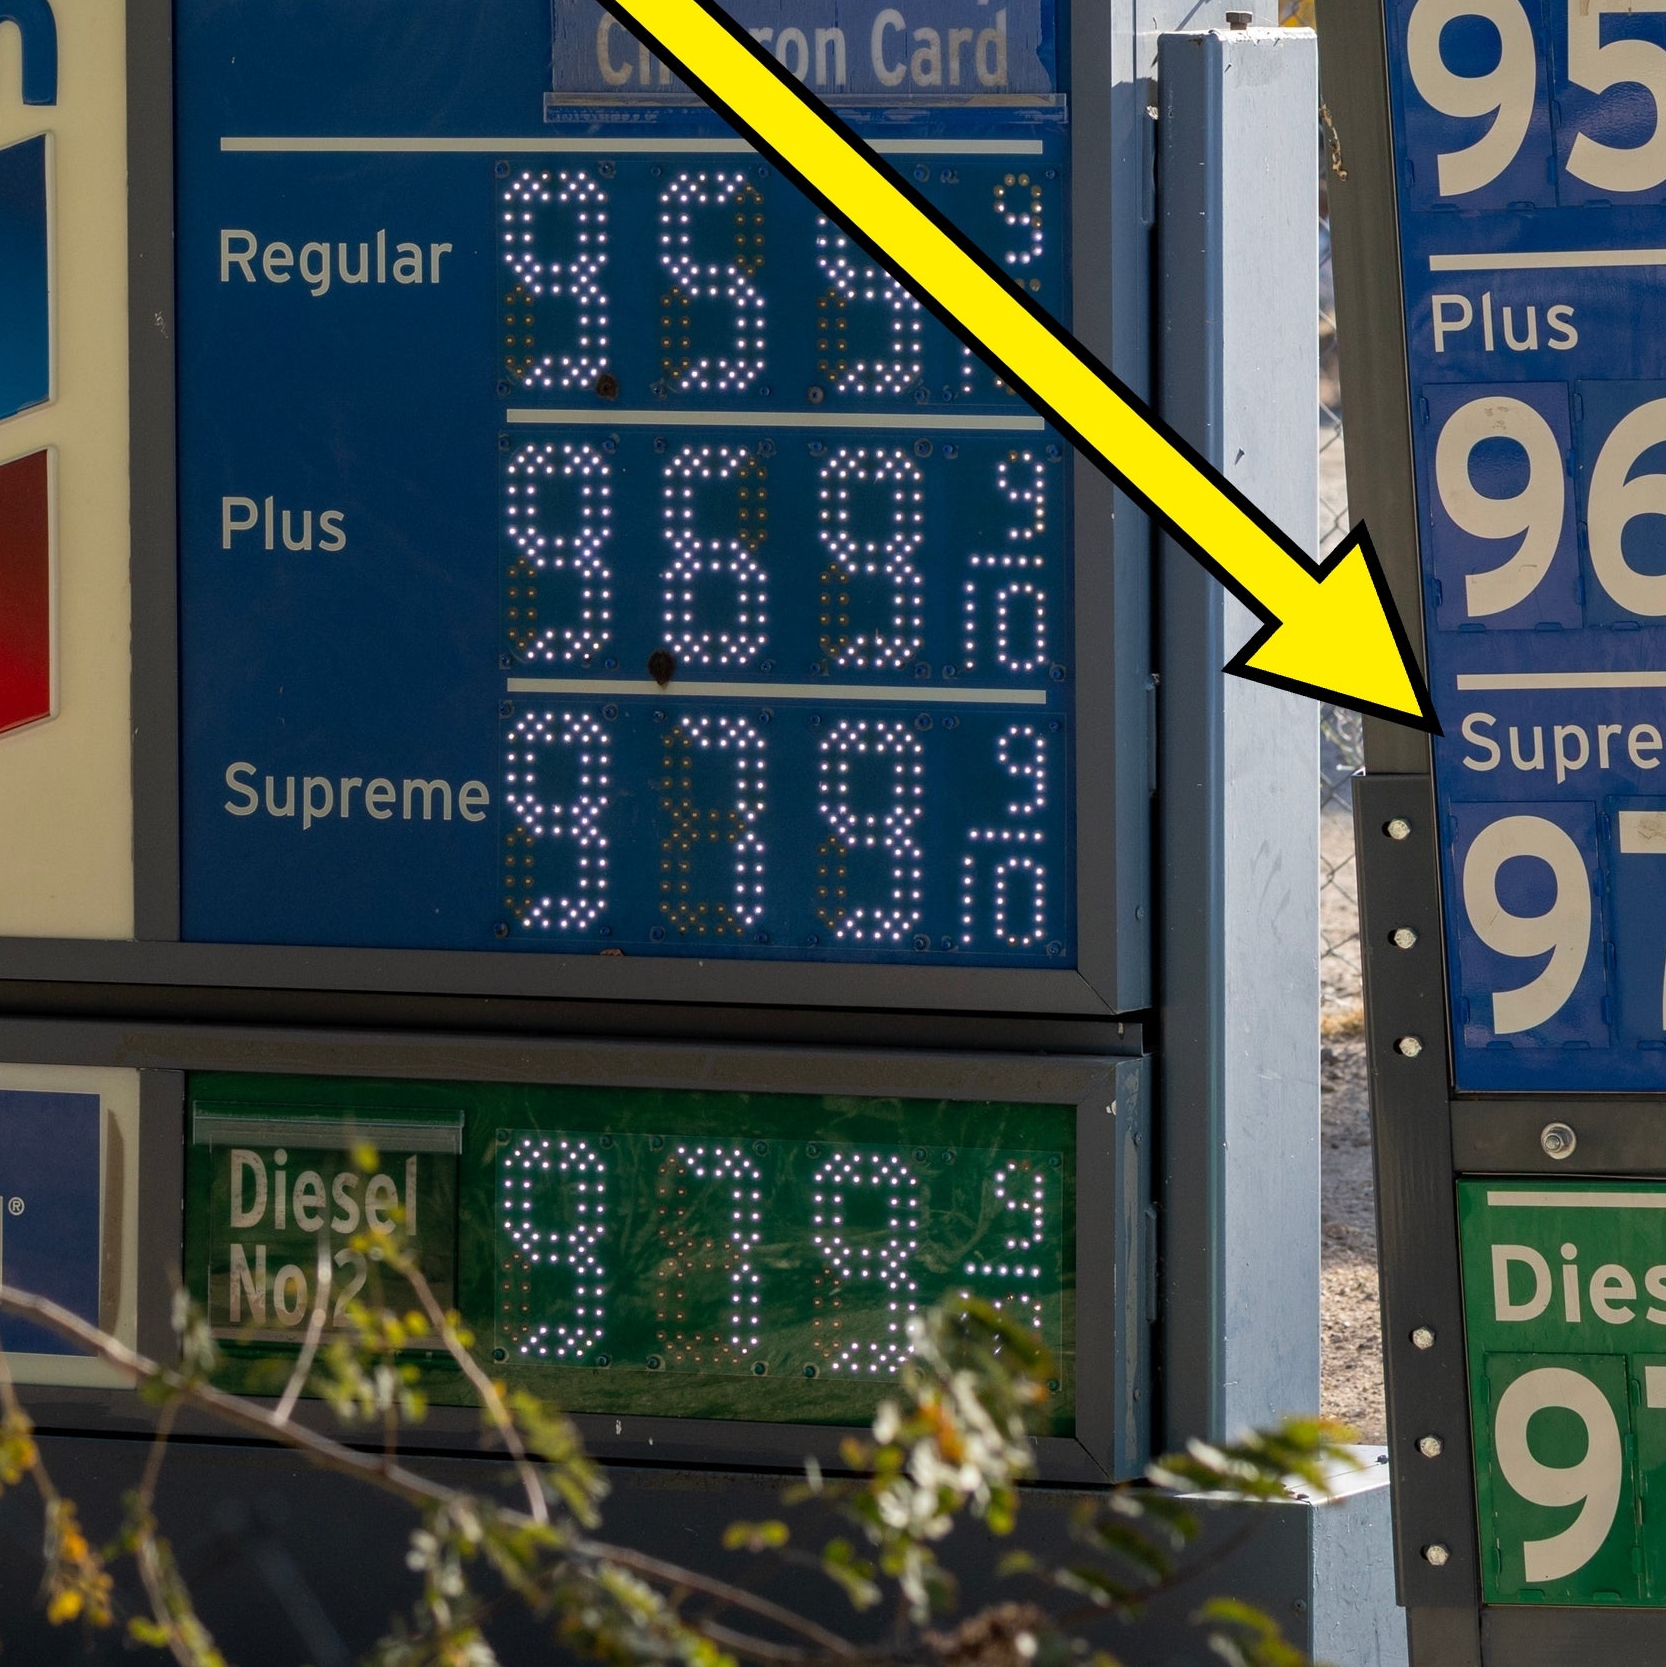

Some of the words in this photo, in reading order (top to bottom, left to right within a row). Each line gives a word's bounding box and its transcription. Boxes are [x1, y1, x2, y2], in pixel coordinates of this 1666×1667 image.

[871, 8, 1008, 87] Card
[221, 229, 453, 298] Regular
[1432, 293, 1577, 352] Plus
[222, 495, 347, 552] Plus
[507, 444, 924, 666] 969
[225, 762, 490, 830] Supreme
[505, 710, 923, 941] 979
[231, 1148, 417, 1236] Diesel
[230, 1244, 367, 1327] No2
[503, 1139, 919, 1373] 979
